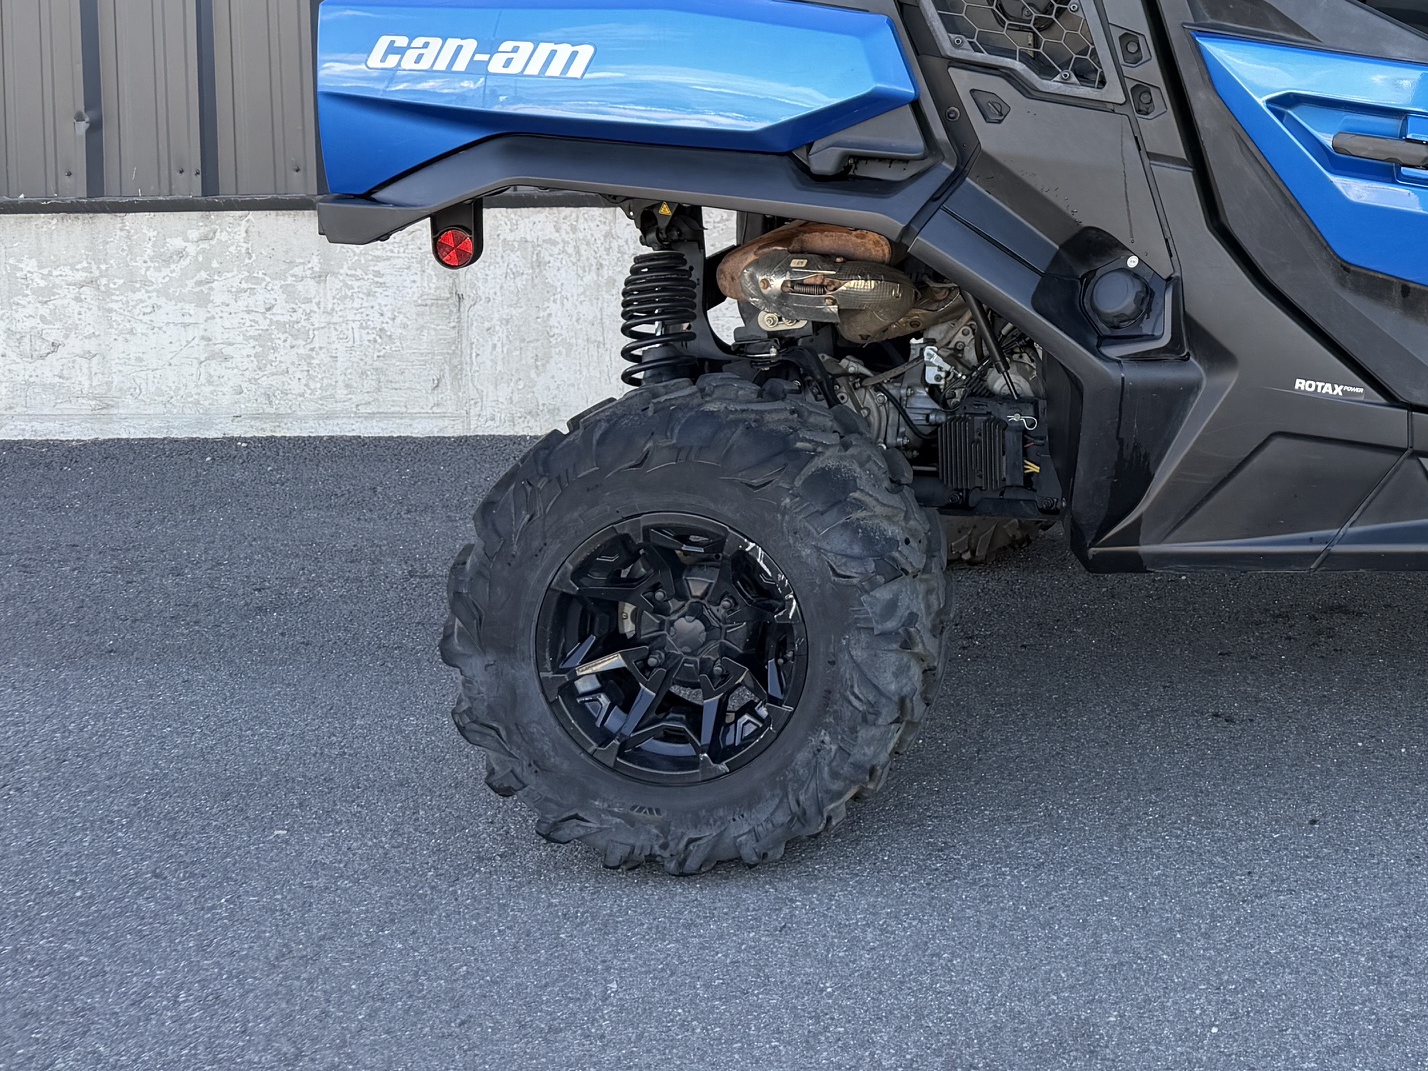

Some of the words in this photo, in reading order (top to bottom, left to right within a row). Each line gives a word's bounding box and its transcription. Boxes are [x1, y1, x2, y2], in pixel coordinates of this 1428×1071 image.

[366, 35, 595, 78] can-am
[1294, 378, 1343, 396] ROTAX
[1343, 385, 1364, 393] POWER
